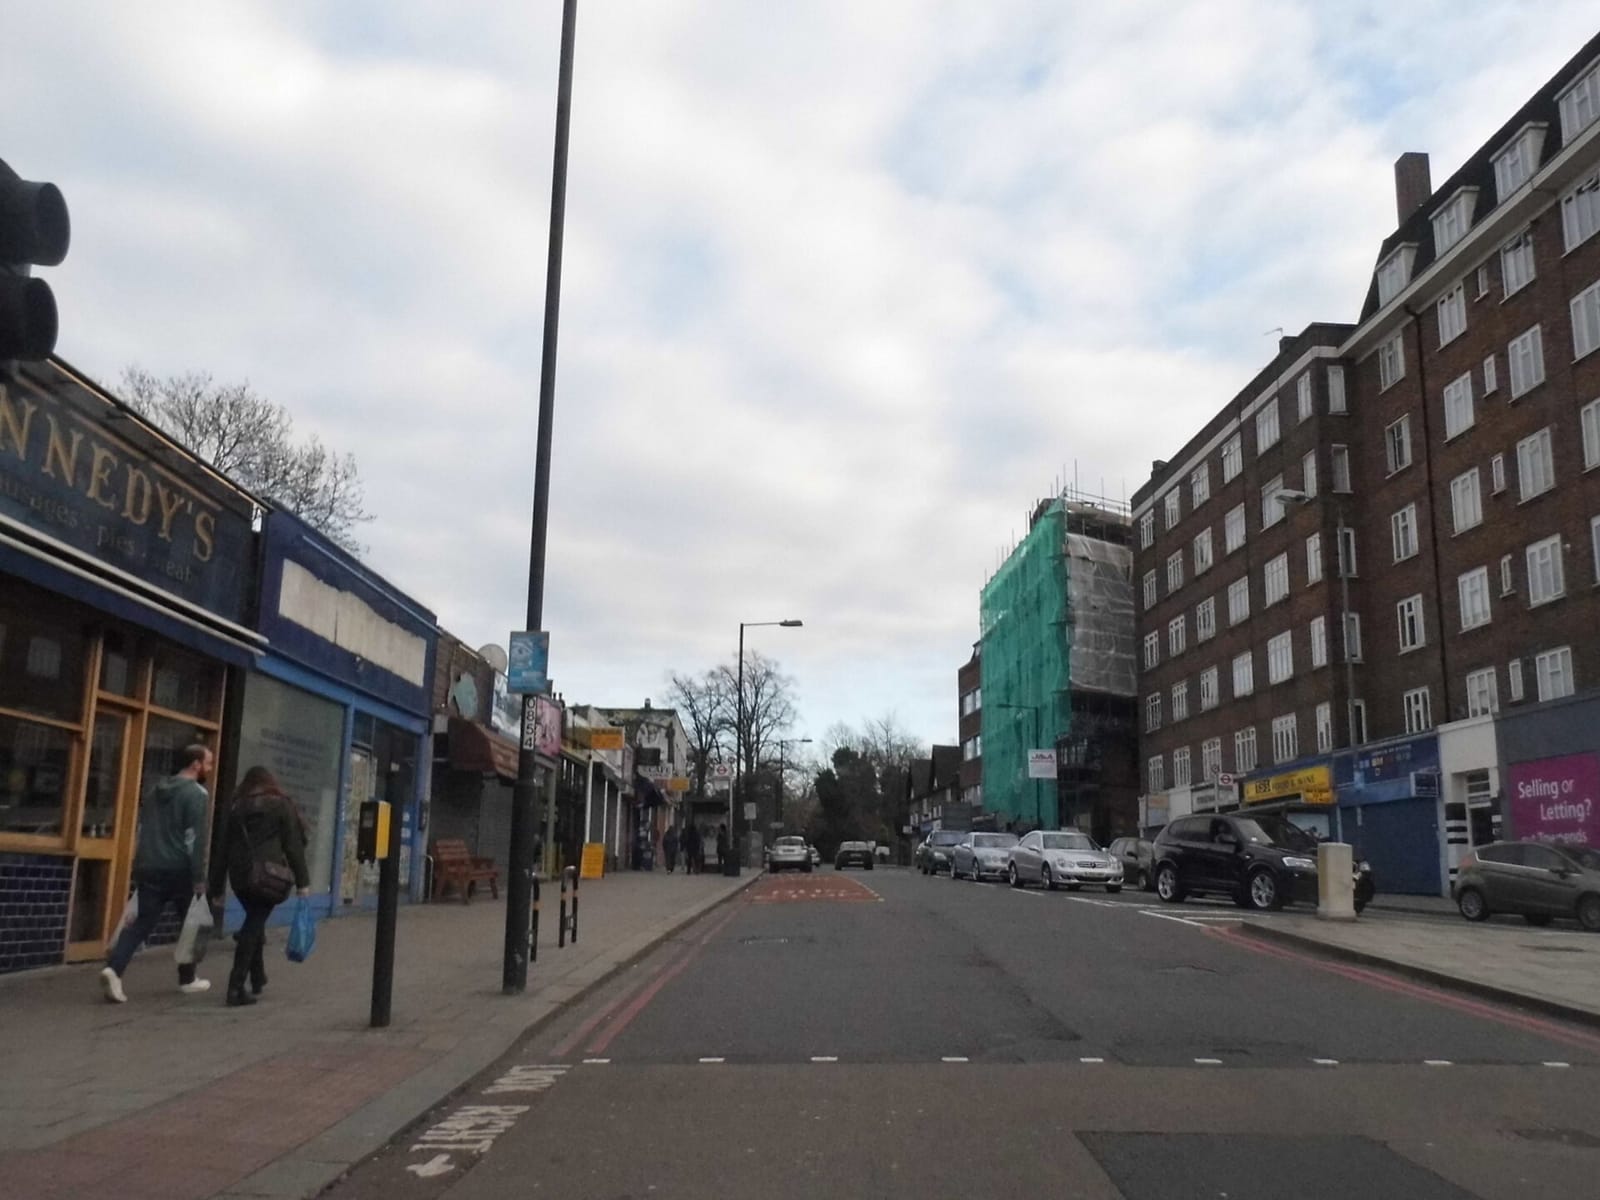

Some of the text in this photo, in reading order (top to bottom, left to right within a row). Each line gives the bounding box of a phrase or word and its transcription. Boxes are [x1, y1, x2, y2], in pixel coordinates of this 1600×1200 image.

[523, 697, 537, 749] 0854
[1518, 779, 1575, 800] Selling or
[1540, 798, 1592, 822] Letting?
